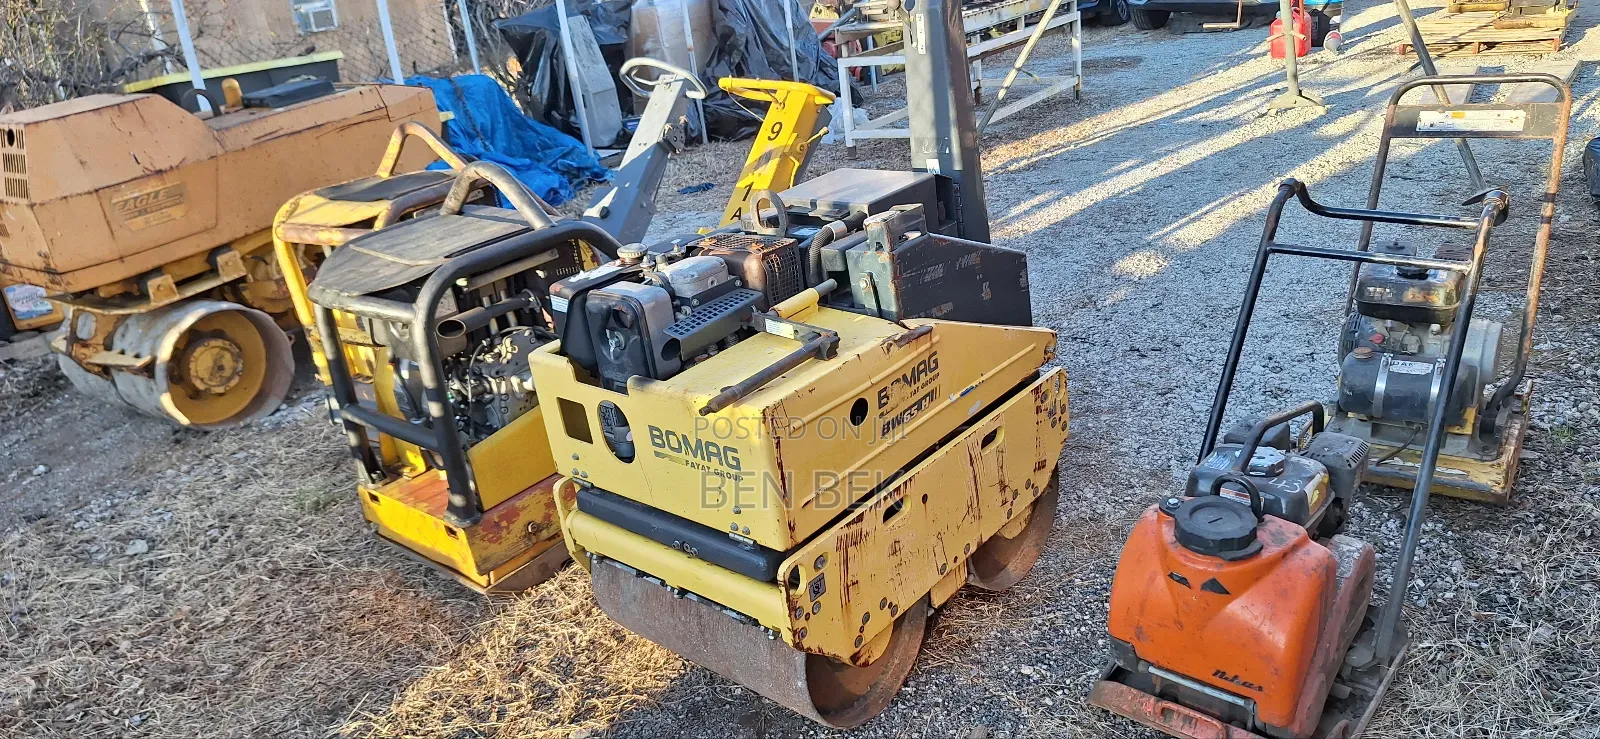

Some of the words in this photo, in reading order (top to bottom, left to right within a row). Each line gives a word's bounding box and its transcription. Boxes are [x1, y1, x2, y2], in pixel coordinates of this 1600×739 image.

[767, 121, 783, 141] 9
[742, 182, 754, 201] 1
[730, 207, 742, 220] A
[920, 372, 940, 389] GROUP
[647, 424, 742, 471] BOMAG
[685, 459, 711, 473] FAYAT
[713, 468, 744, 482] GROUP
